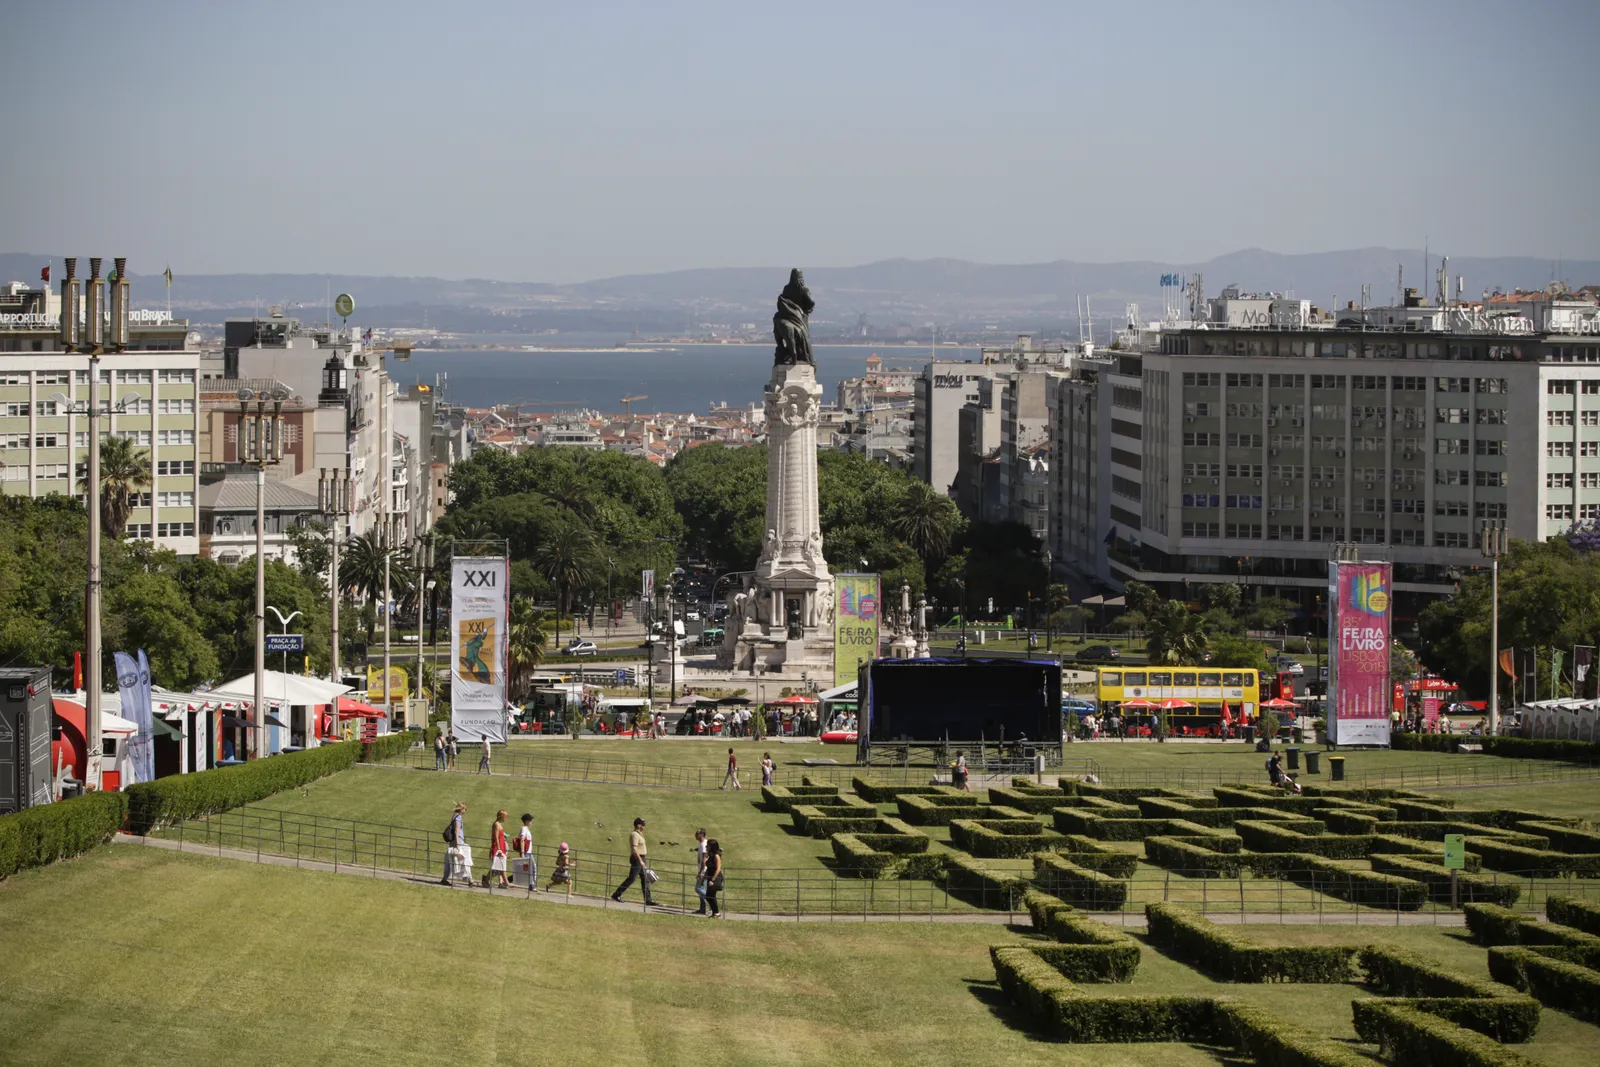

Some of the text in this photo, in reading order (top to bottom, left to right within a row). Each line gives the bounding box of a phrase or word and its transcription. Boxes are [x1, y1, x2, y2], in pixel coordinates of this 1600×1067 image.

[141, 309, 173, 321] BRASIL
[463, 570, 496, 587] XXI
[468, 622, 485, 633] XXI
[840, 627, 872, 636] FEIRA
[1343, 628, 1383, 638] FEIRA
[840, 637, 873, 645] LIVRO
[1343, 639, 1385, 650] LIVRO
[1343, 651, 1385, 661] LISBOA
[1357, 662, 1385, 672] 2015
